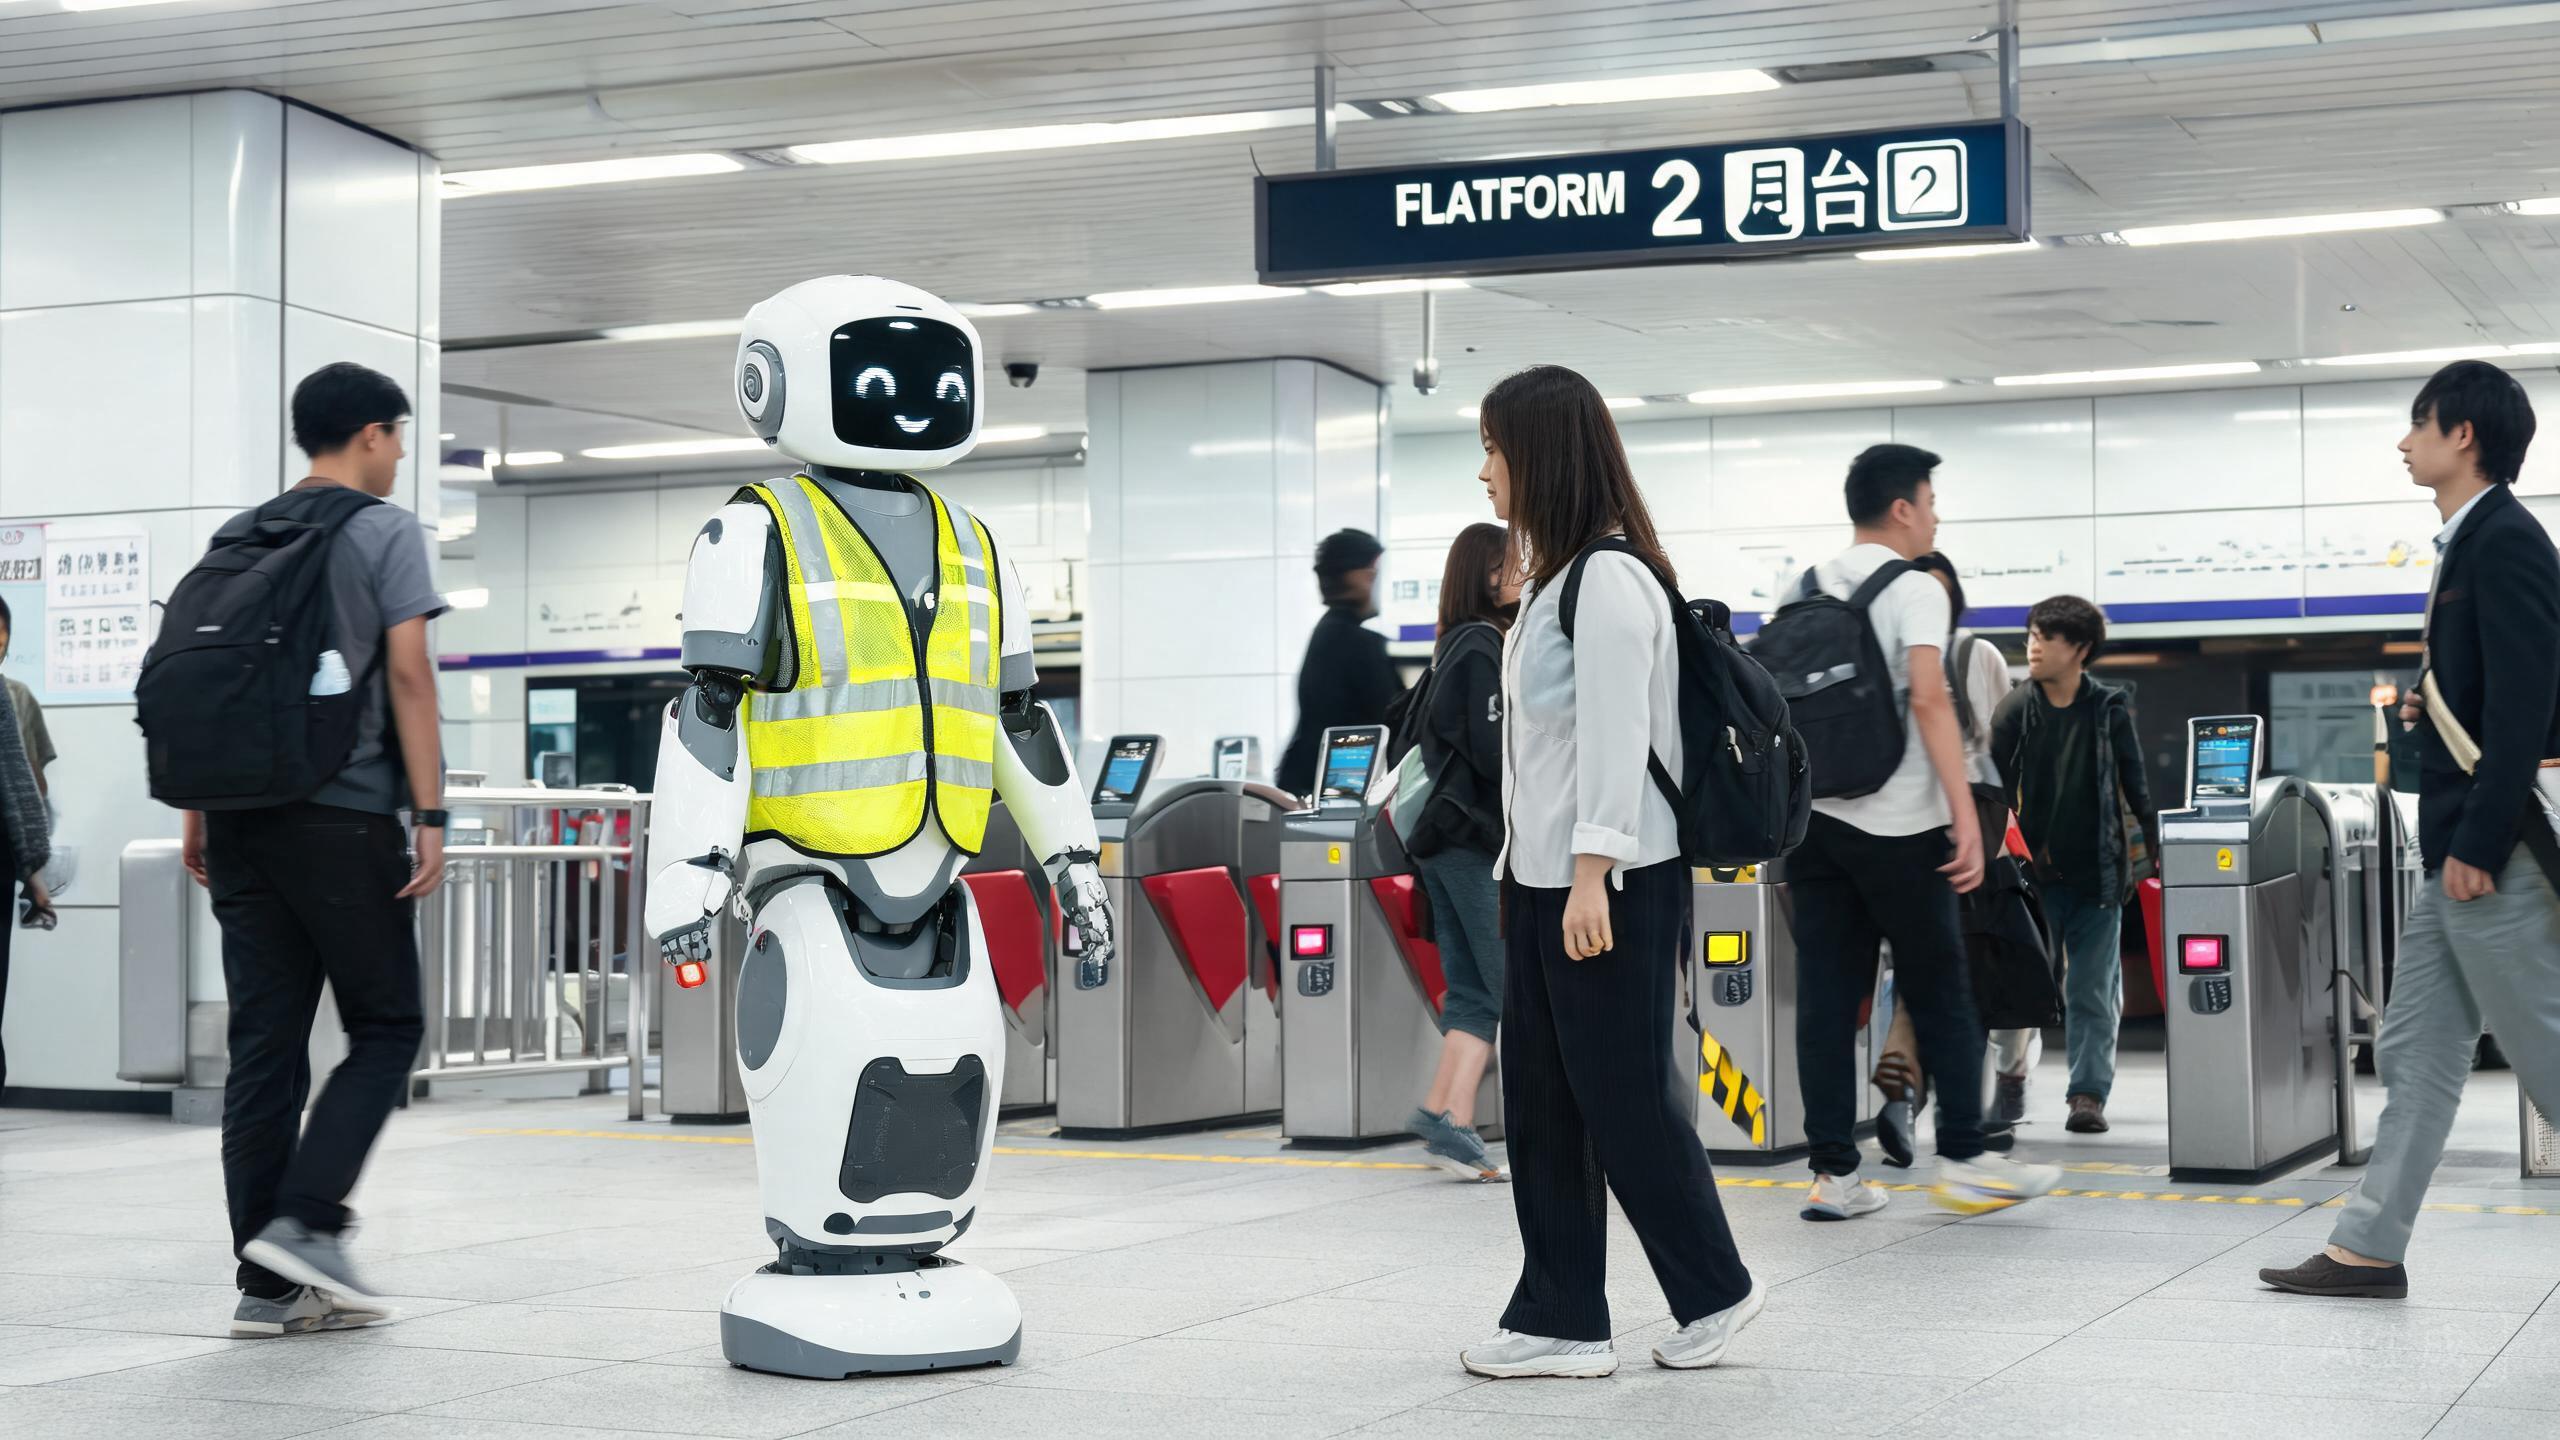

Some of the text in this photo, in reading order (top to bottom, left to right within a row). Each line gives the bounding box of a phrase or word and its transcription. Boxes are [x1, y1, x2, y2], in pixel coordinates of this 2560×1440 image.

[1395, 170, 1626, 227] FLATFORM
[1651, 158, 1703, 237] 2
[1738, 147, 1870, 233] 月台
